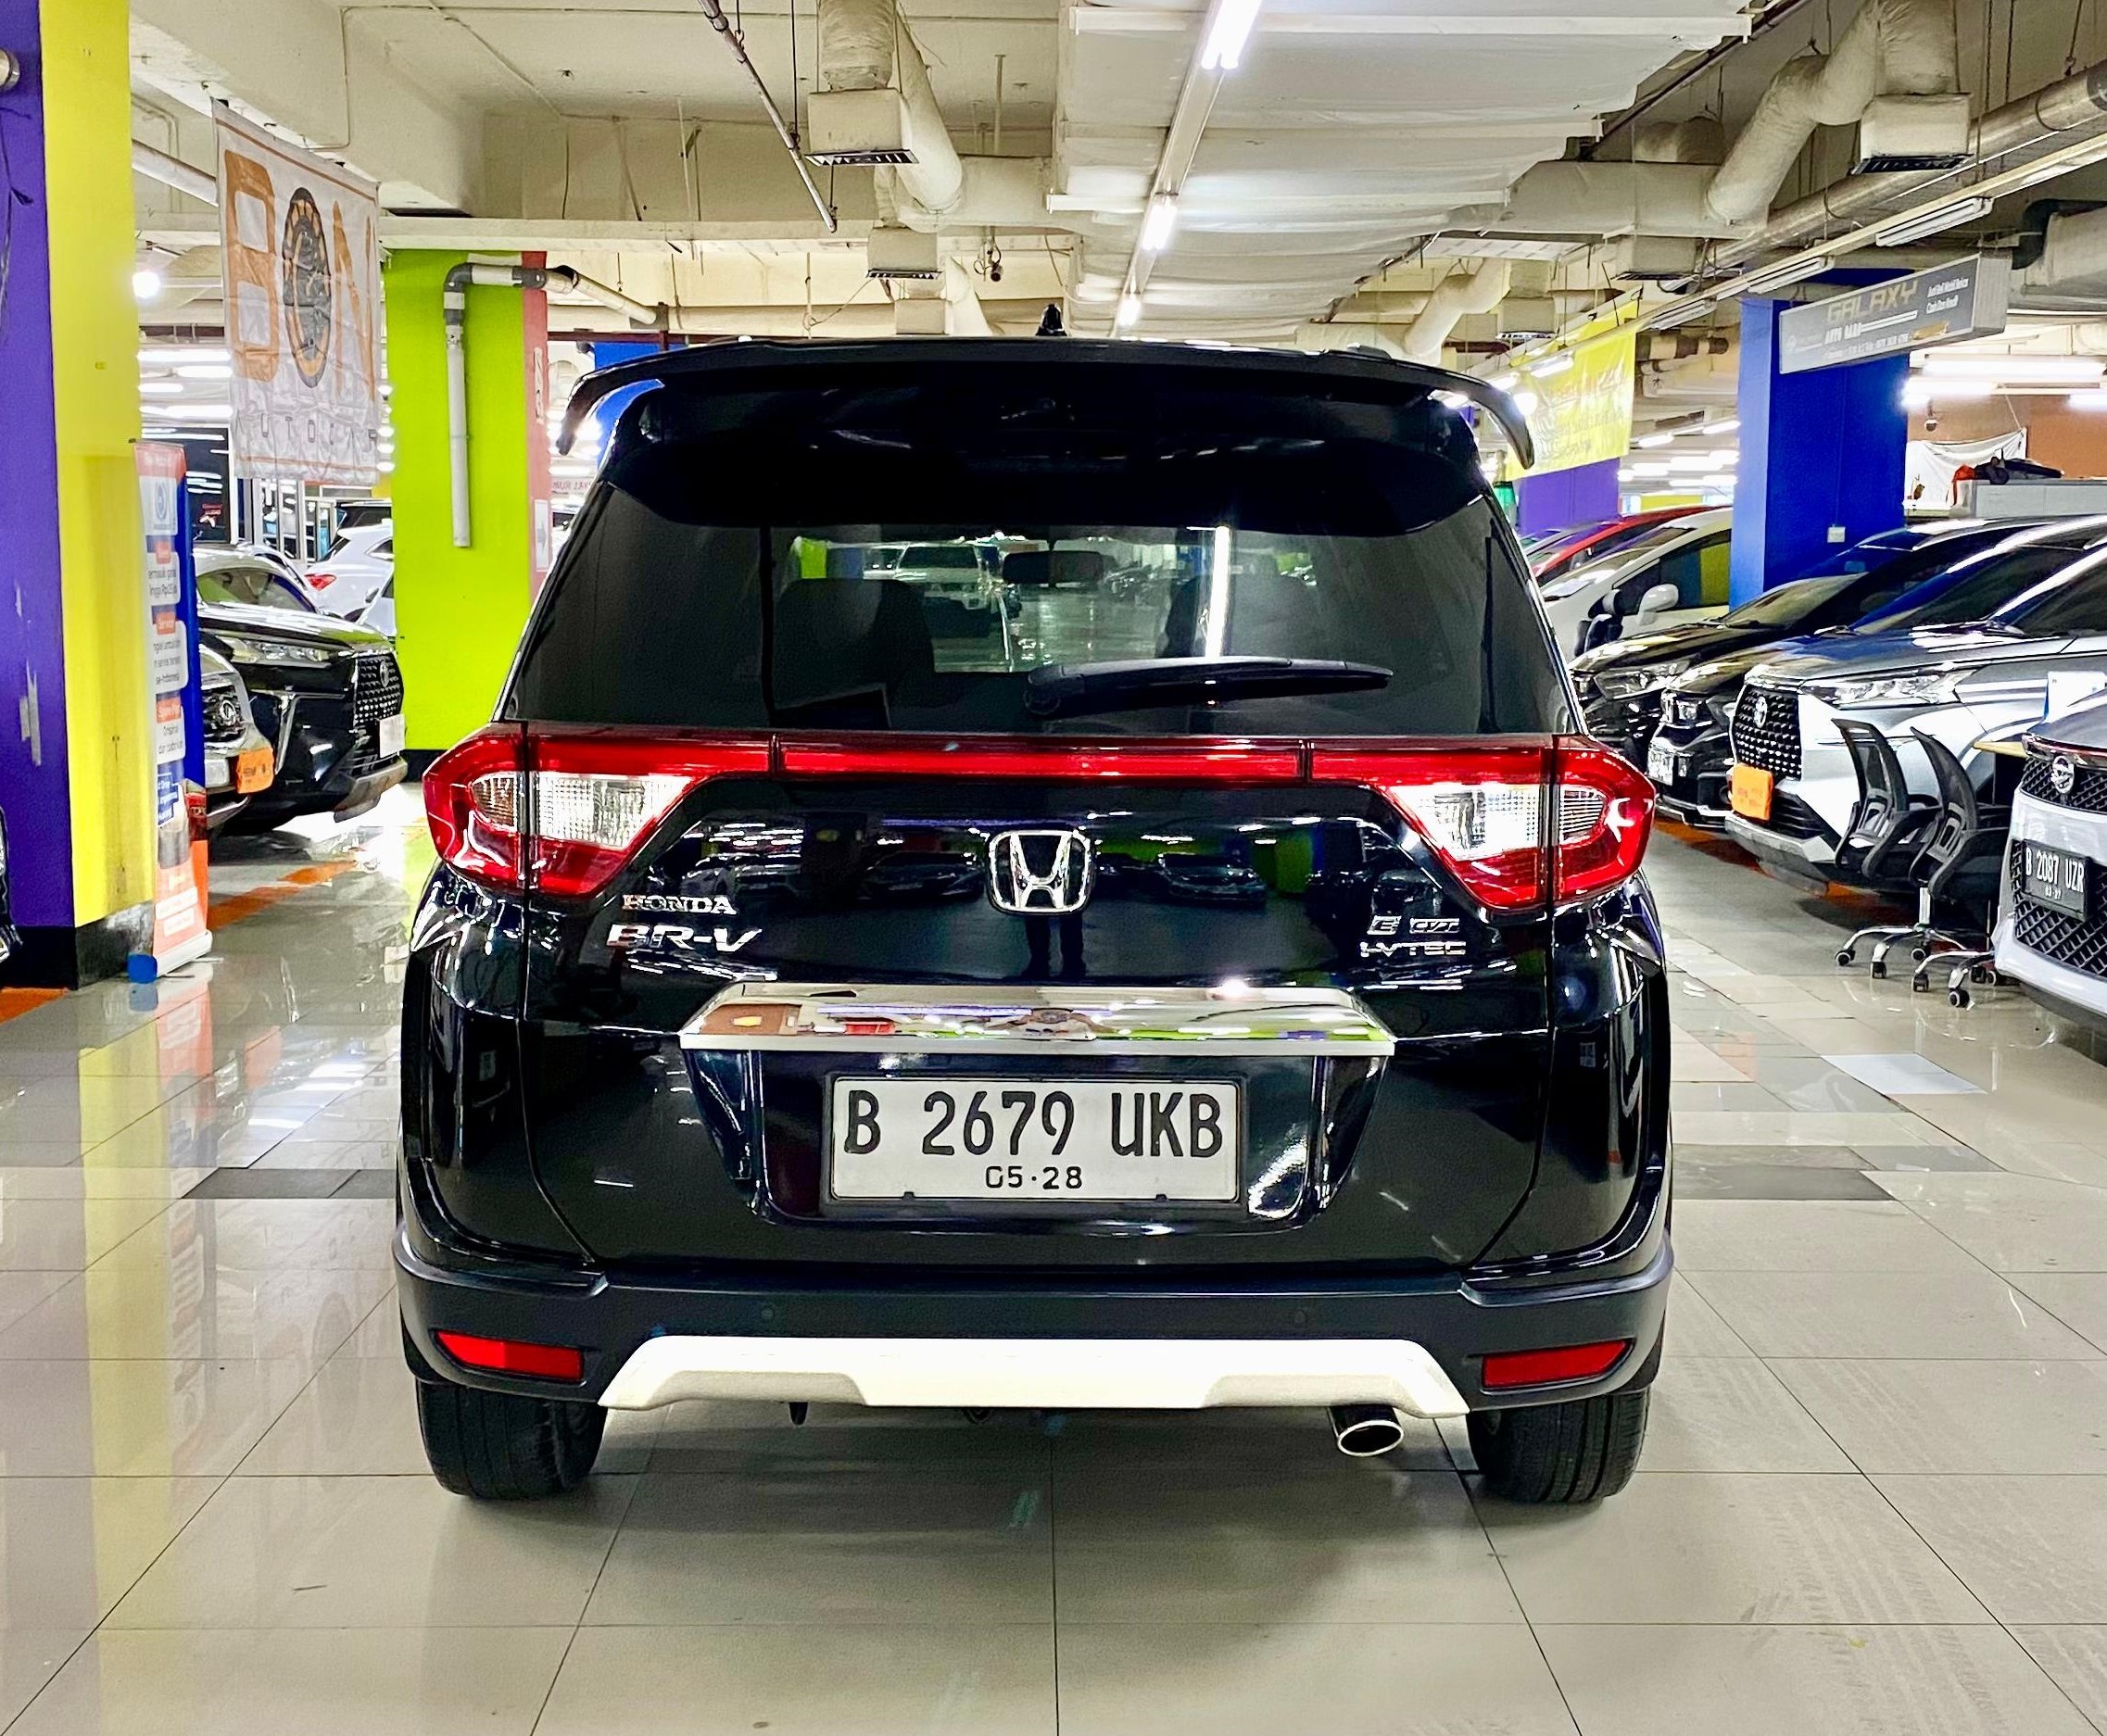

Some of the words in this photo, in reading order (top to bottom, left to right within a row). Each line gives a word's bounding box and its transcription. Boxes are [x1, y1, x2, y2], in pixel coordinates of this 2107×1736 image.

[1825, 280, 1919, 324] GALAXY
[2025, 847, 2033, 876] B
[2036, 850, 2060, 885] 2087
[2065, 858, 2085, 893] UZR
[622, 894, 738, 915] HONDA
[606, 924, 763, 952] BR-V
[1409, 917, 1460, 934] CVT
[844, 1089, 881, 1154] B
[922, 1090, 1075, 1156] 2679
[1111, 1092, 1223, 1158] UKB
